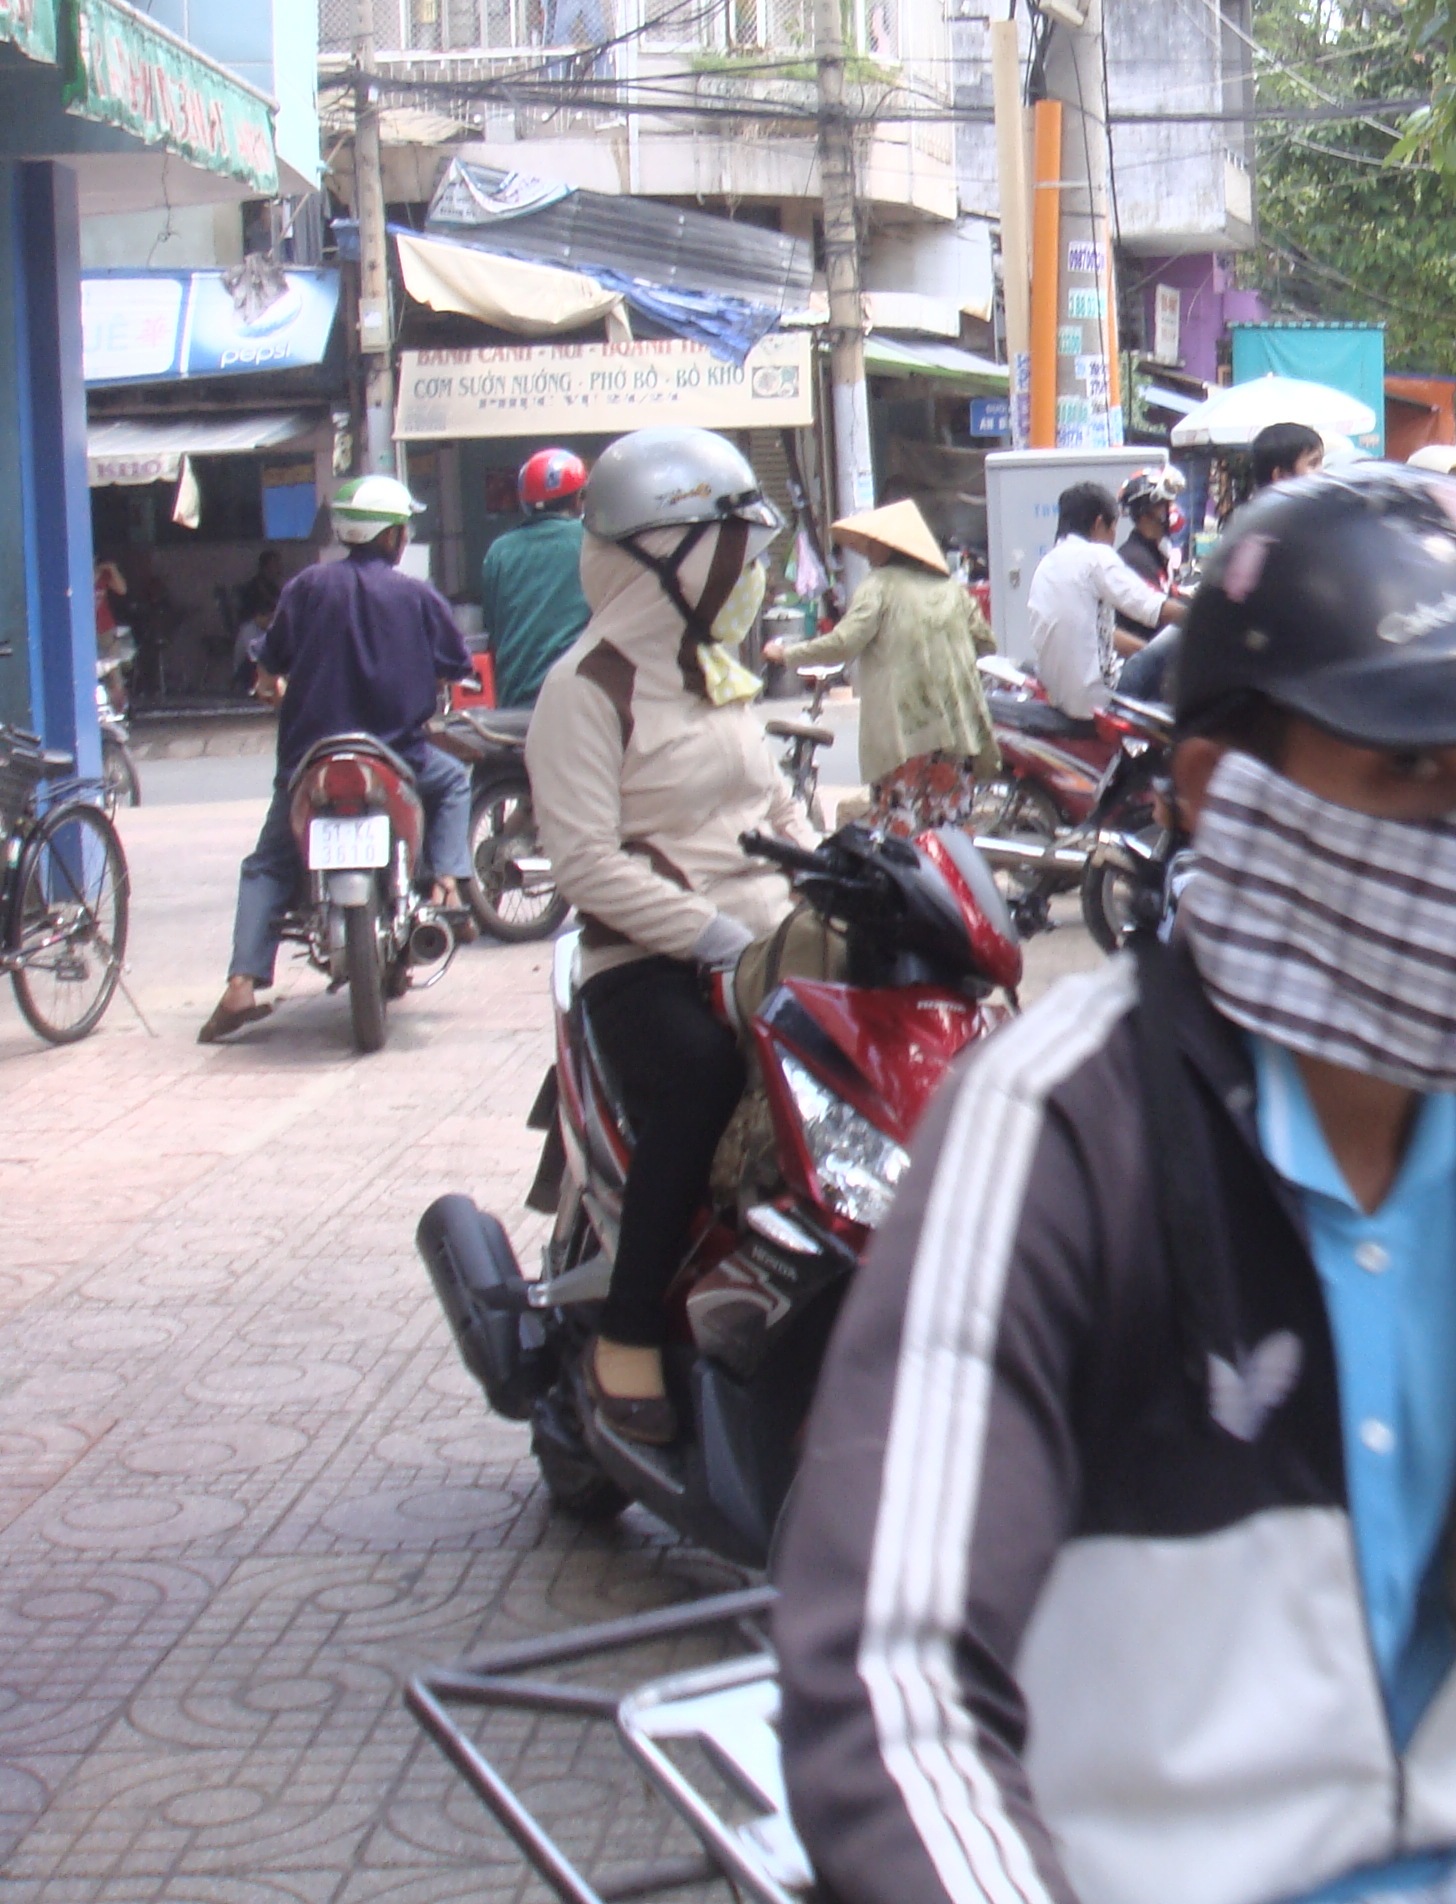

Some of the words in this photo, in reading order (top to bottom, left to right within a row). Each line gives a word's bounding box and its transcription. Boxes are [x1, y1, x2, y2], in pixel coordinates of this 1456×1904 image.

[220, 341, 291, 369] pepsi
[413, 376, 453, 399] CƠM
[511, 368, 572, 395] NƯỚNG
